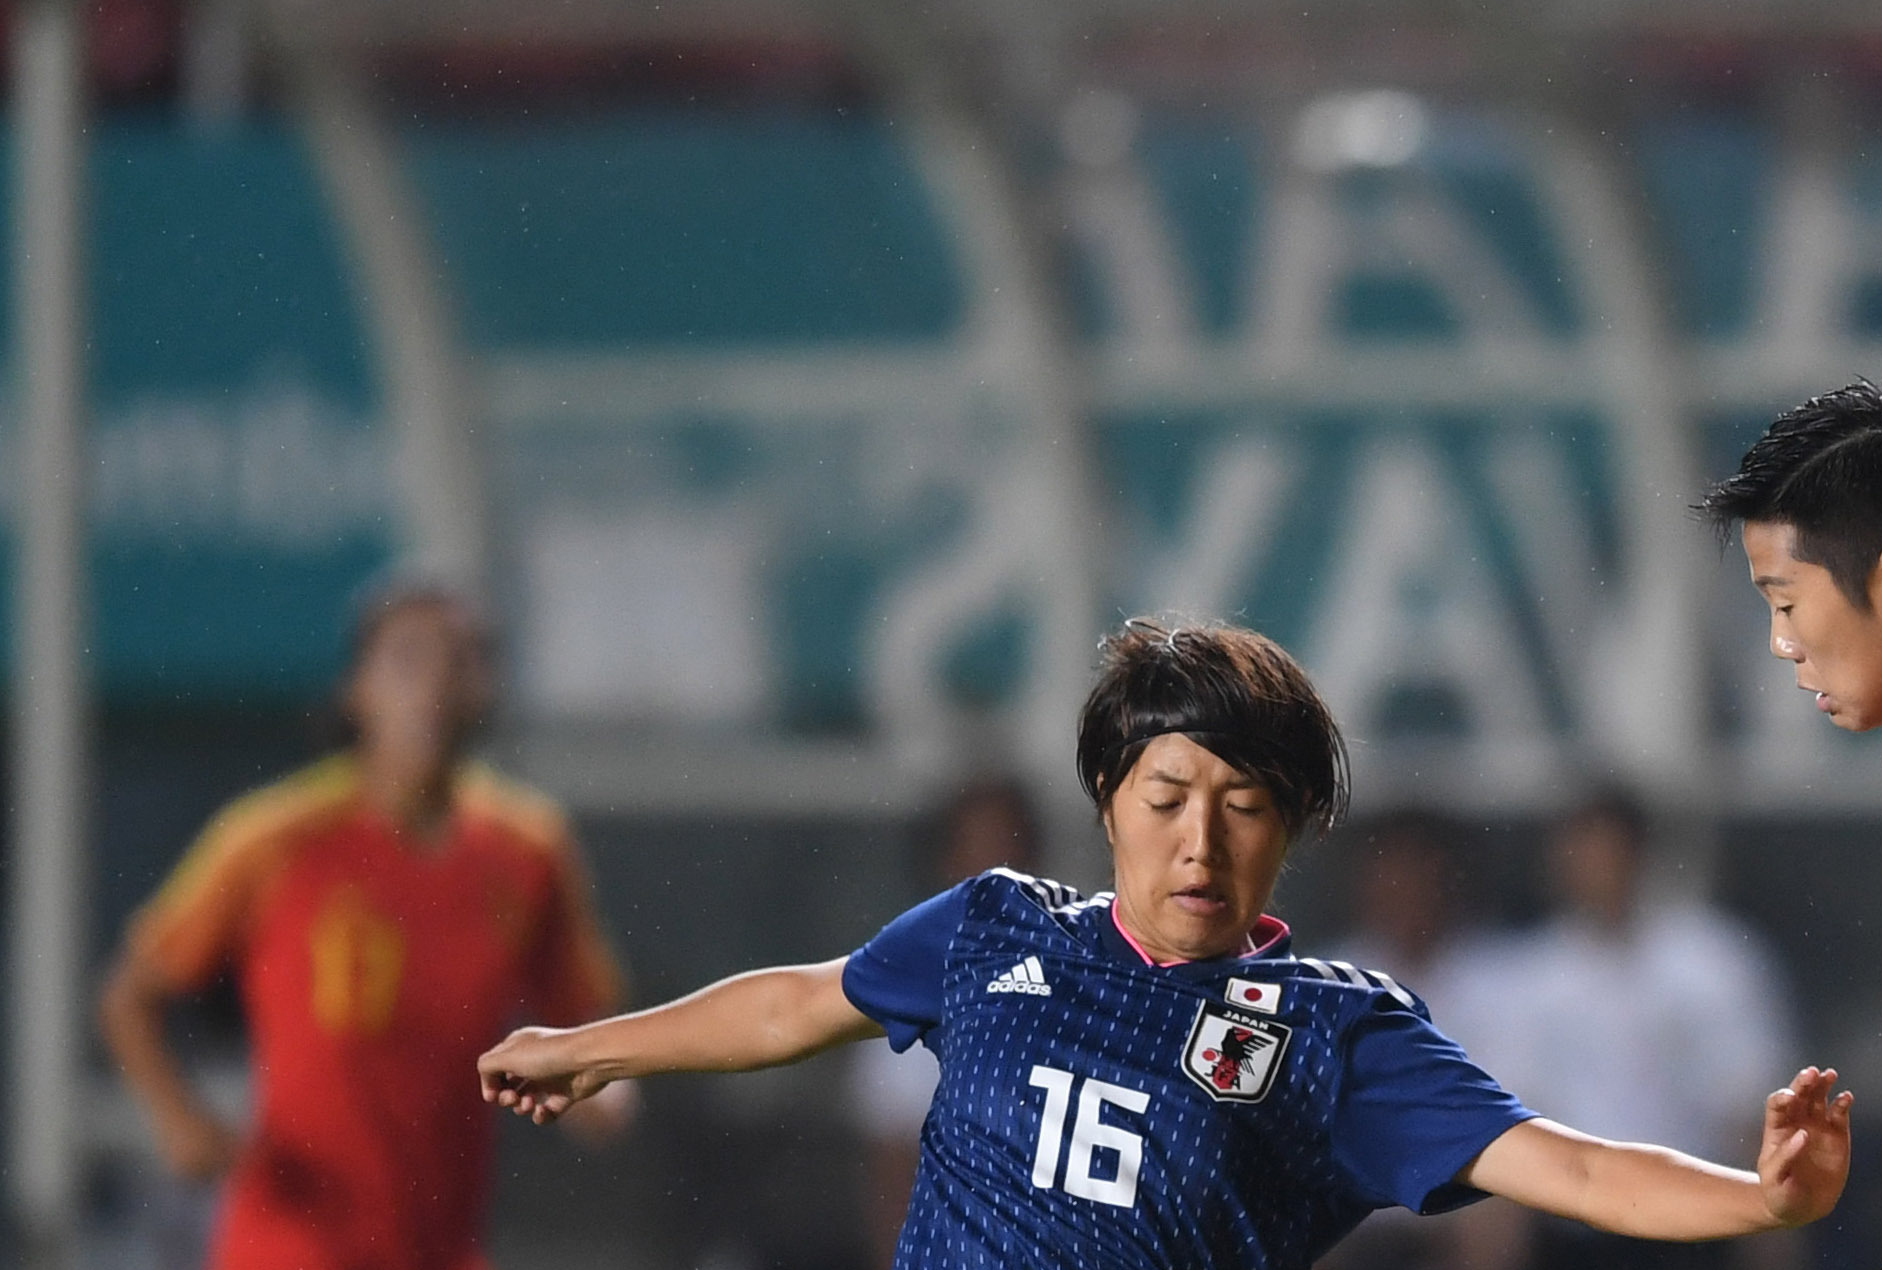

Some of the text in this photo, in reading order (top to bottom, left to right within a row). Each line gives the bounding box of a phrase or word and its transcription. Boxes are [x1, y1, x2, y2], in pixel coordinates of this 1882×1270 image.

[985, 978, 1052, 997] adidas
[1223, 1010, 1269, 1030] JAPAN
[1028, 1064, 1151, 1208] 16
